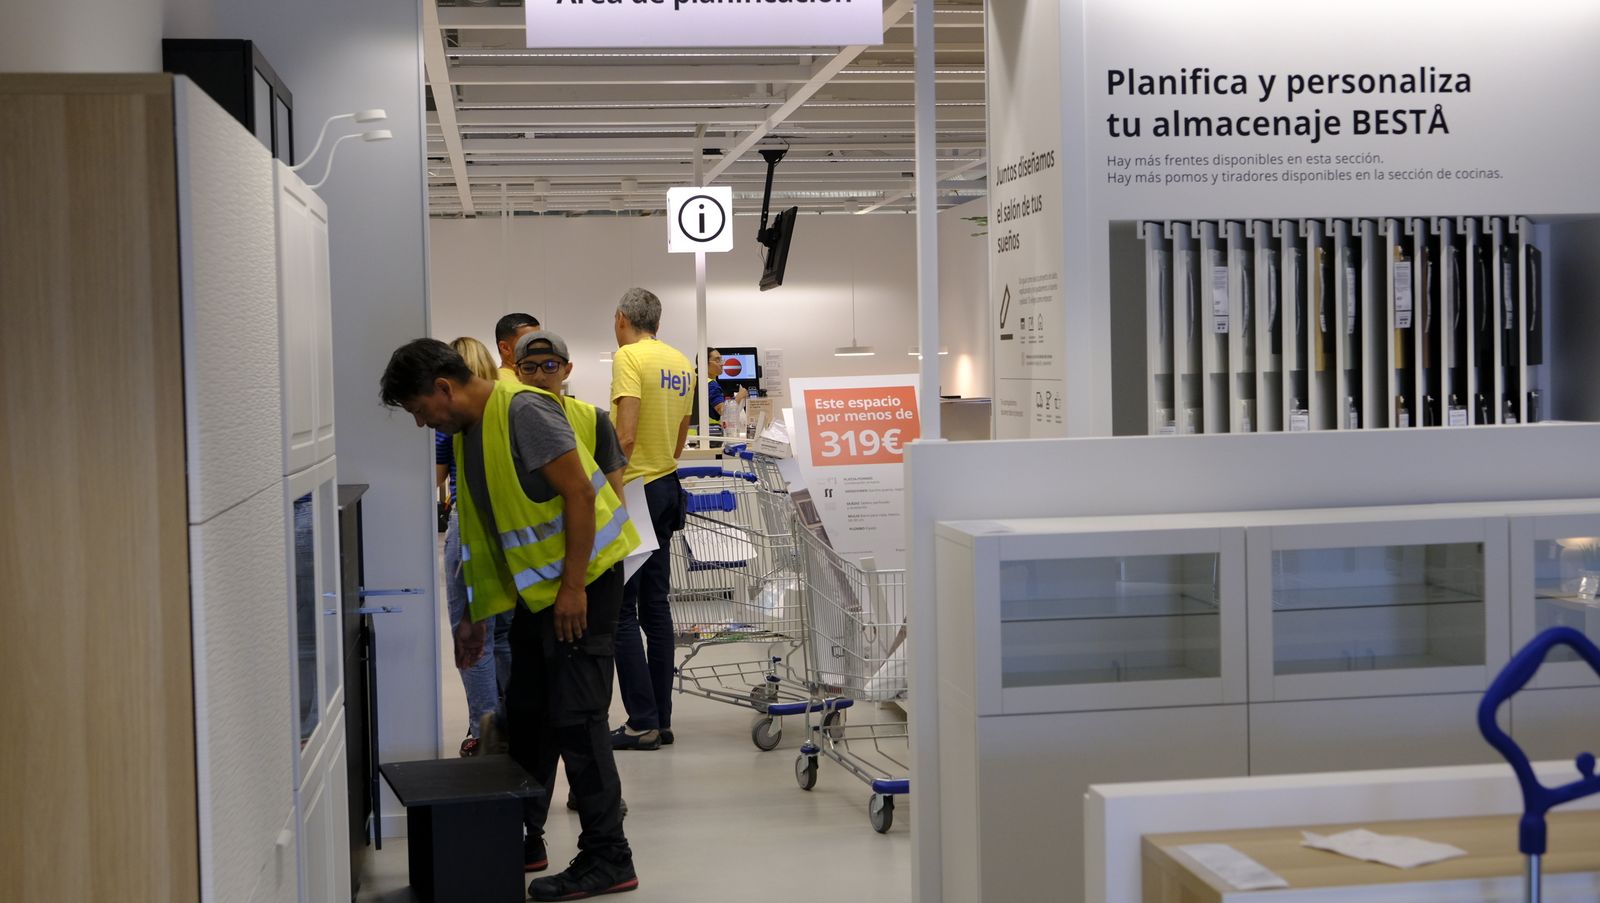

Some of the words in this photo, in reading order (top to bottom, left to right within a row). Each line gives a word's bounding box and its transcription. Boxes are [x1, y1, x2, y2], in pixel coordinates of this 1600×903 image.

[1107, 68, 1248, 96] Planifica
[1259, 74, 1276, 103] y
[1288, 67, 1472, 103] personaliza
[1107, 113, 1141, 138] tu
[1153, 109, 1342, 144] almacenaje
[1353, 104, 1450, 136] BESTÅ
[996, 163, 1018, 187] Juntos
[1018, 150, 1055, 179] diseñamos
[1108, 155, 1132, 170] Hay
[1135, 155, 1162, 167] más
[1165, 154, 1210, 166] frentes
[1213, 154, 1284, 168] disponibles
[1288, 156, 1303, 165] en
[1306, 155, 1332, 165] esta
[1336, 153, 1384, 164] sección.
[1108, 172, 1132, 187] Hay
[1136, 172, 1162, 183] más
[1166, 173, 1209, 186] pomos
[1212, 173, 1219, 186] y
[1222, 171, 1279, 182] tiradores
[1282, 170, 1352, 185] disponibles
[1356, 171, 1371, 181] en
[1375, 169, 1385, 181] la
[1389, 168, 1433, 181] sección
[1437, 168, 1452, 180] de
[1456, 169, 1504, 180] cocinas.
[997, 202, 1003, 224] el
[1004, 198, 1021, 223] salón
[1022, 195, 1031, 217] de
[1032, 194, 1043, 214] tus
[998, 230, 1020, 254] sueños
[660, 369, 692, 397] Hej!
[815, 398, 845, 410] Este
[848, 396, 901, 411] espacio
[817, 412, 841, 426] por
[845, 411, 892, 423] menos
[896, 409, 914, 420] de
[820, 428, 904, 458] 319€
